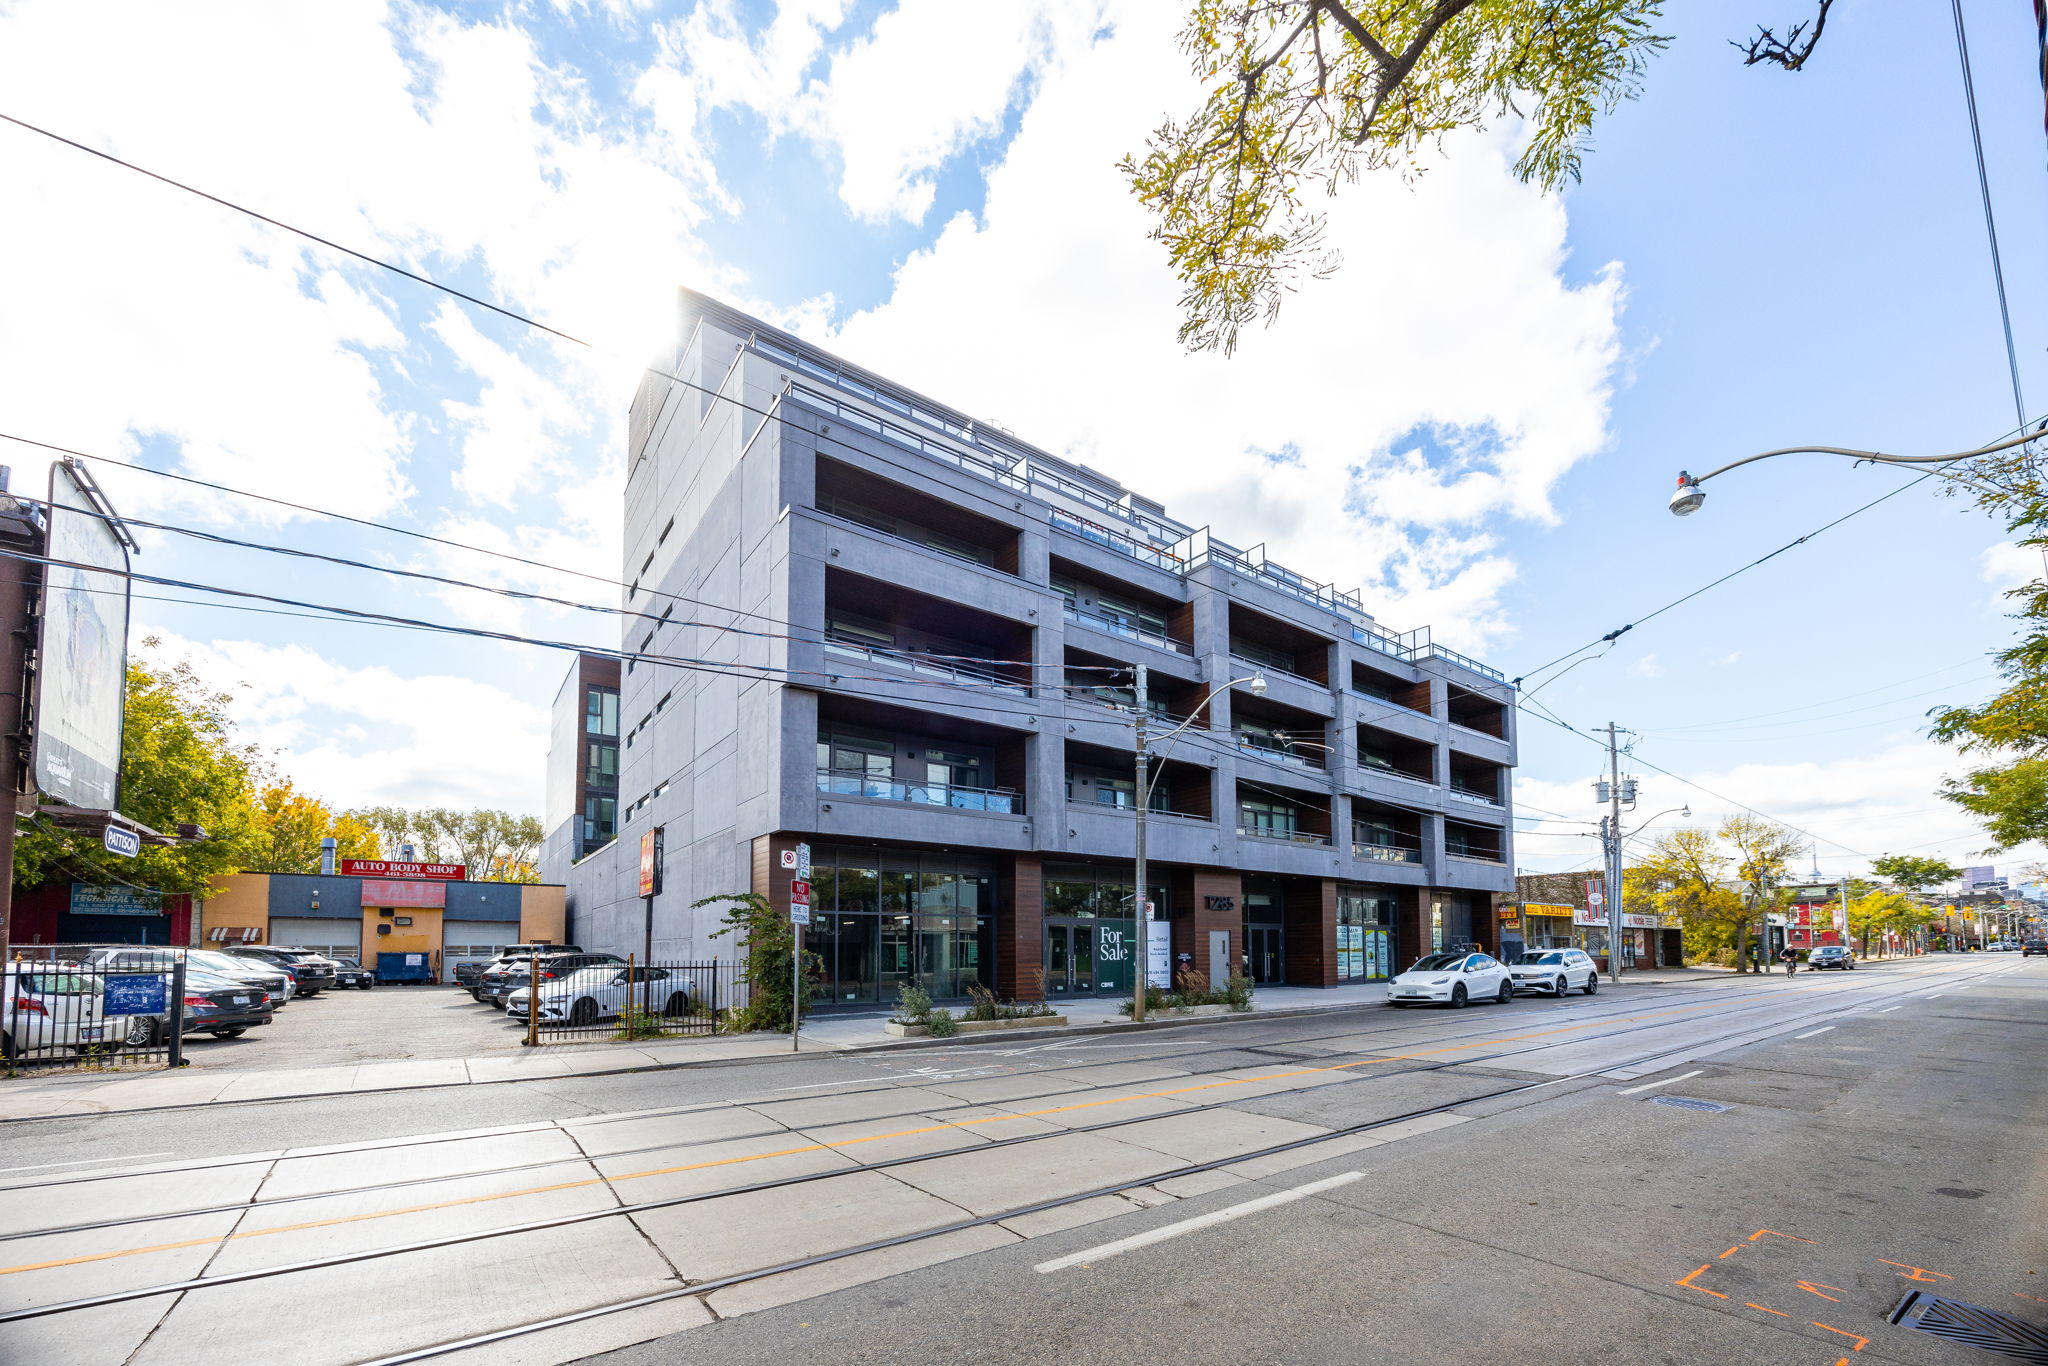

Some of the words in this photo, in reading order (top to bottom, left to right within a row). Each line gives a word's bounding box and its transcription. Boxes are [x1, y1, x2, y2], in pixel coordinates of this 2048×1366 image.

[107, 830, 138, 853] PATTISON
[352, 861, 386, 871] AUTO
[390, 863, 422, 873] BODY
[426, 865, 457, 874] SHOP
[796, 883, 805, 893] NO
[792, 893, 809, 904] PASSING
[1540, 905, 1573, 916] VARIETY
[1100, 926, 1122, 944] For
[1100, 944, 1128, 961] Sale
